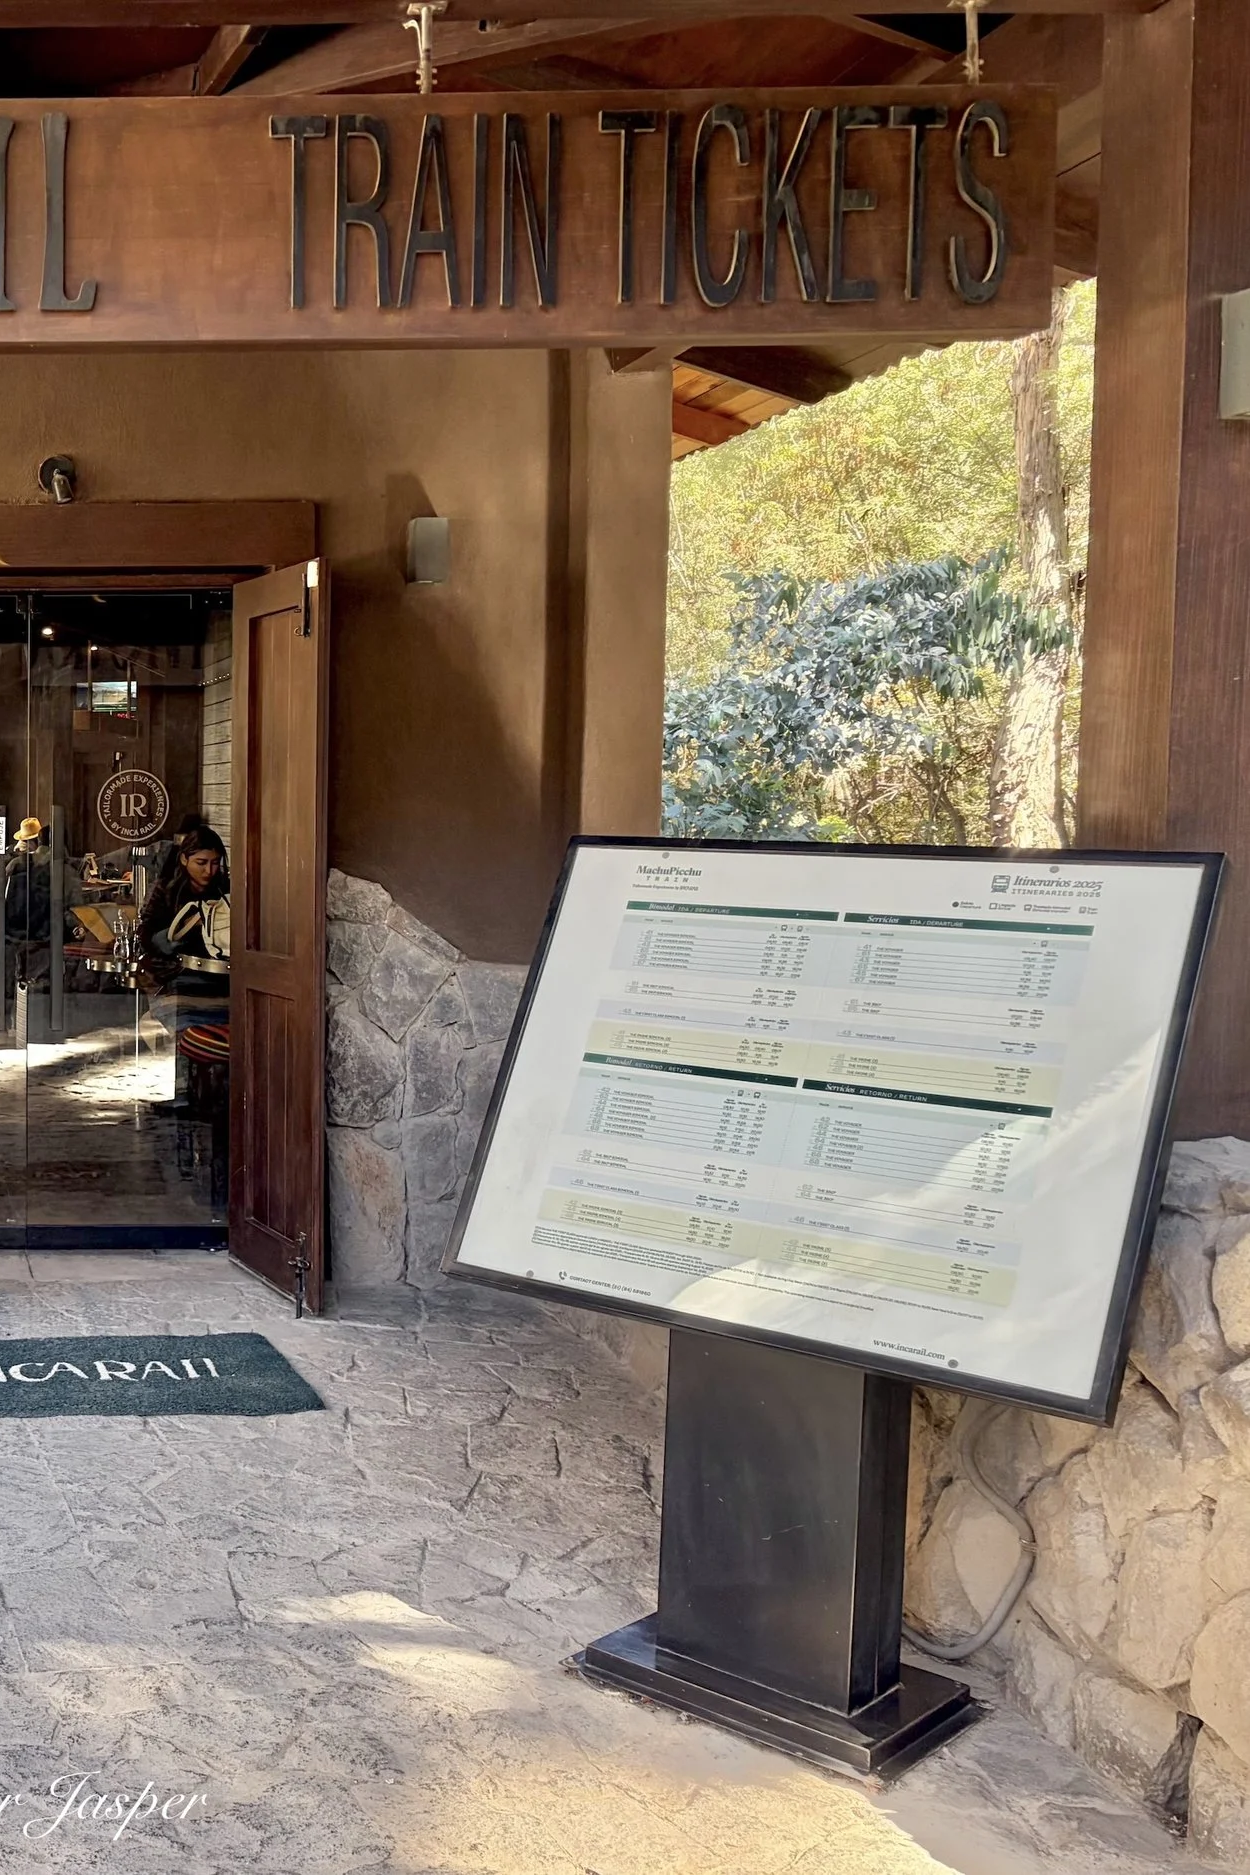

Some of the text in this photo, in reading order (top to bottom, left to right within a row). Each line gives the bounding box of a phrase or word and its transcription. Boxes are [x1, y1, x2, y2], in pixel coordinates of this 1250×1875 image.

[269, 102, 1010, 309] TRAIN TICKETS
[103, 774, 165, 820] TAILORMADE EXPERIENCES
[119, 793, 148, 817] IR
[111, 821, 157, 837] BY INCA RAIL
[636, 865, 702, 877] MachuPicchu
[1013, 875, 1104, 892] Itinerarios 2025
[1011, 888, 1074, 897] ITINERARIES
[694, 907, 731, 915] DEPARTURE
[926, 920, 964, 928] DEPARTURE
[635, 1062, 663, 1070] RETORNO
[668, 1065, 693, 1074] RETURN
[825, 1082, 856, 1094] Servicios
[859, 1088, 893, 1098] RETORNO
[899, 1093, 928, 1102] RETURN
[570, 1275, 592, 1284] CONTACT
[873, 1339, 946, 1361] www.incarail.com
